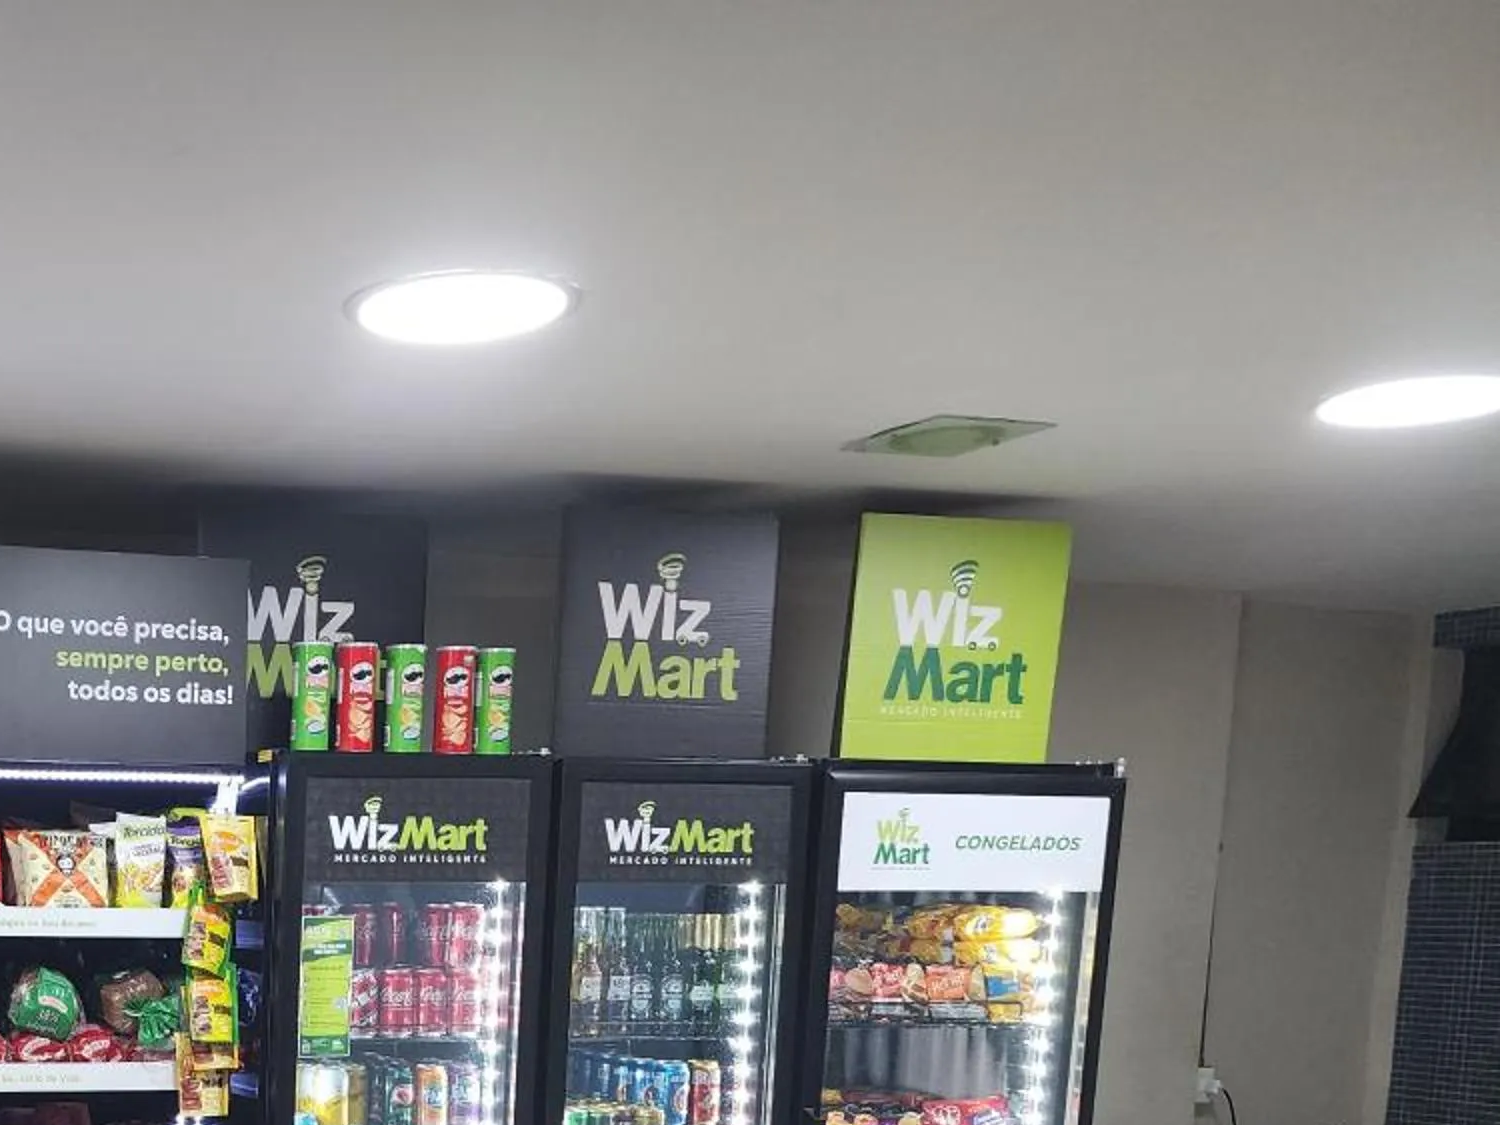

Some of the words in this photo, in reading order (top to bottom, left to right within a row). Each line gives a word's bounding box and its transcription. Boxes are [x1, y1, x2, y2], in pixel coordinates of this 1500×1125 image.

[597, 580, 712, 647] Wiz
[892, 587, 1004, 652] Wiz
[17, 614, 61, 640] que
[70, 614, 129, 638] você
[134, 618, 231, 648] precisa,
[55, 648, 150, 674] sempre
[155, 652, 231, 677] perto,
[591, 641, 741, 702] Mart
[883, 645, 1028, 705] Mart
[68, 679, 138, 703] todos
[144, 684, 171, 705] os
[176, 682, 235, 707] dias!
[328, 813, 488, 852] WizMart
[604, 816, 755, 856] WizMart
[876, 817, 921, 844] Wiz
[955, 833, 1083, 853] CONGELADOS
[334, 853, 398, 863] MERCADO
[404, 853, 487, 864] INTELIGENTE
[609, 856, 669, 866] MERCADO
[873, 842, 931, 867] Mart
